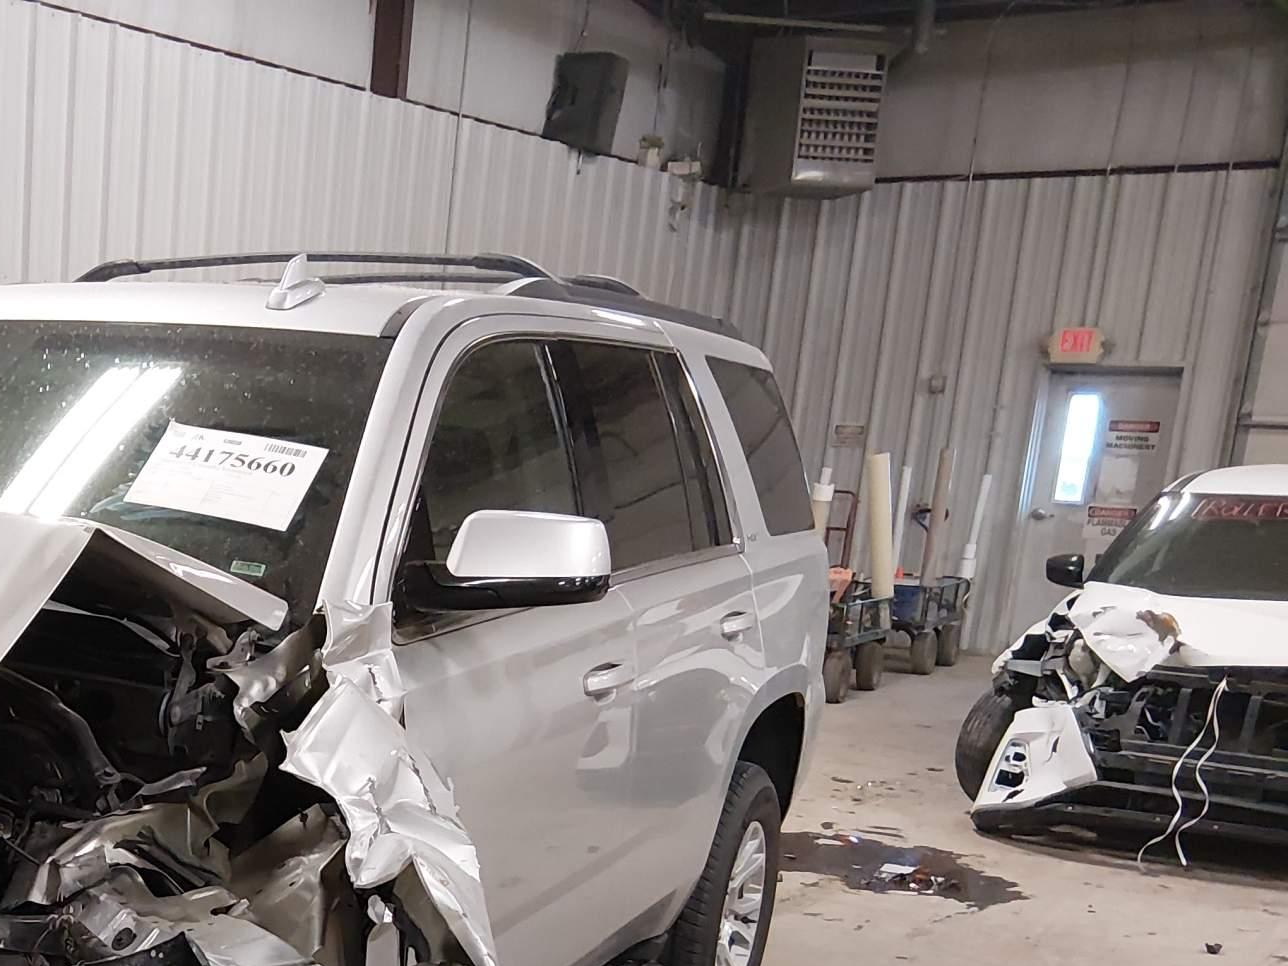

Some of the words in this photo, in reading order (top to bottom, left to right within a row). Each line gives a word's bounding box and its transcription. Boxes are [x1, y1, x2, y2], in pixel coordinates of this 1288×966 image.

[1061, 330, 1093, 352] EXIT
[1115, 434, 1150, 443] MOVING
[1106, 442, 1156, 451] MACHINERY
[169, 445, 296, 478] 44175660
[1101, 527, 1117, 537] GAS
